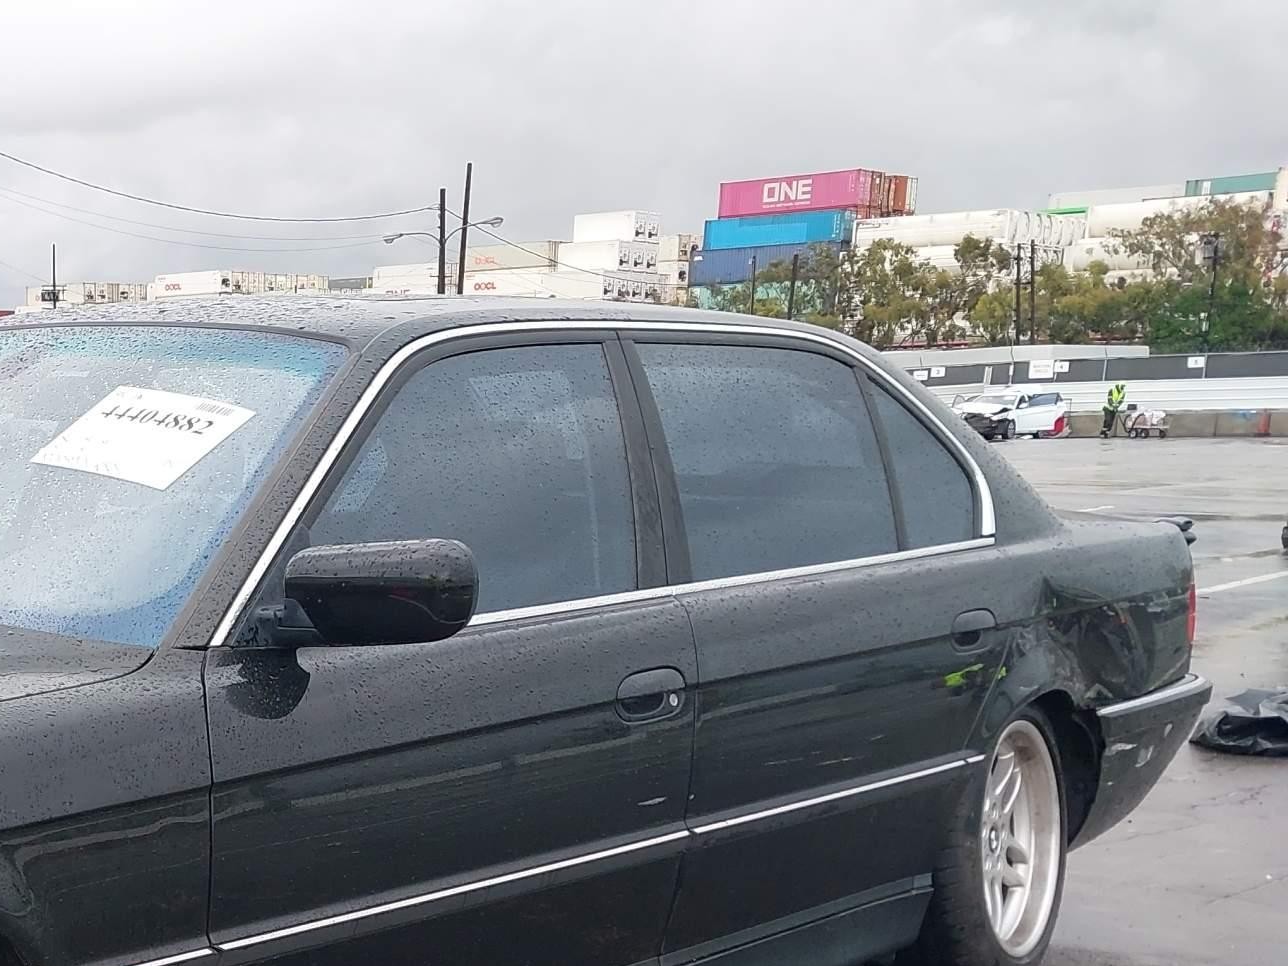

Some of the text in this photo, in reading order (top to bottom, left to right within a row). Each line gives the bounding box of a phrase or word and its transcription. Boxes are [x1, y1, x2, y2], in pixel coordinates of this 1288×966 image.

[763, 179, 812, 203] ONE
[165, 283, 182, 291] OOCL
[474, 281, 496, 291] OOCL
[102, 404, 214, 435] 44404882
